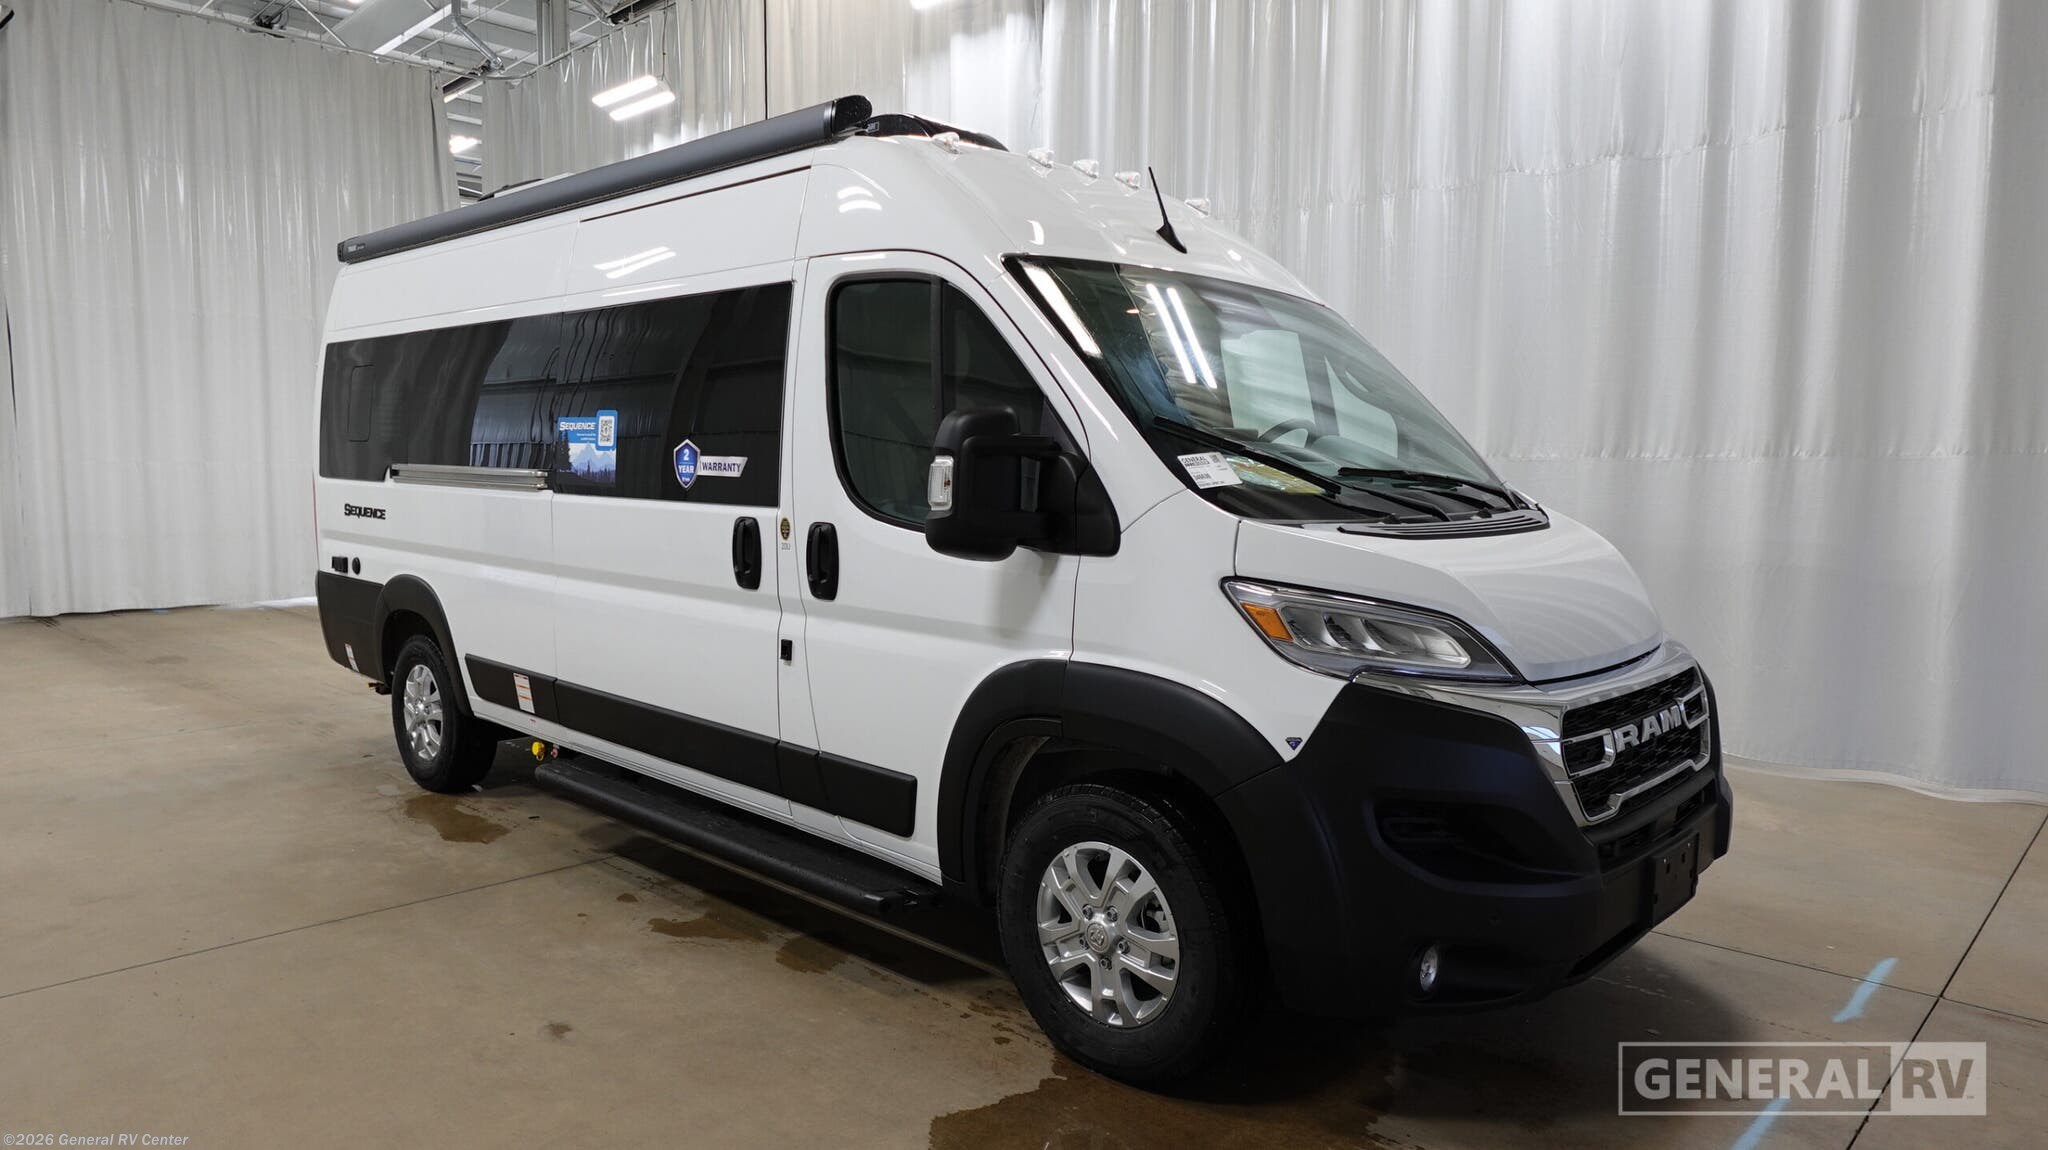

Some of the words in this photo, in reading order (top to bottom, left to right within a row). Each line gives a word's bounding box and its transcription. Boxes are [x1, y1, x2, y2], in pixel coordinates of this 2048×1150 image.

[559, 421, 596, 431] SEQUENCE
[683, 448, 690, 461] 2
[678, 464, 695, 474] YEAR
[702, 462, 741, 472] WARRANTY
[344, 503, 386, 520] SEQUENCE
[1613, 705, 1682, 753] RAM
